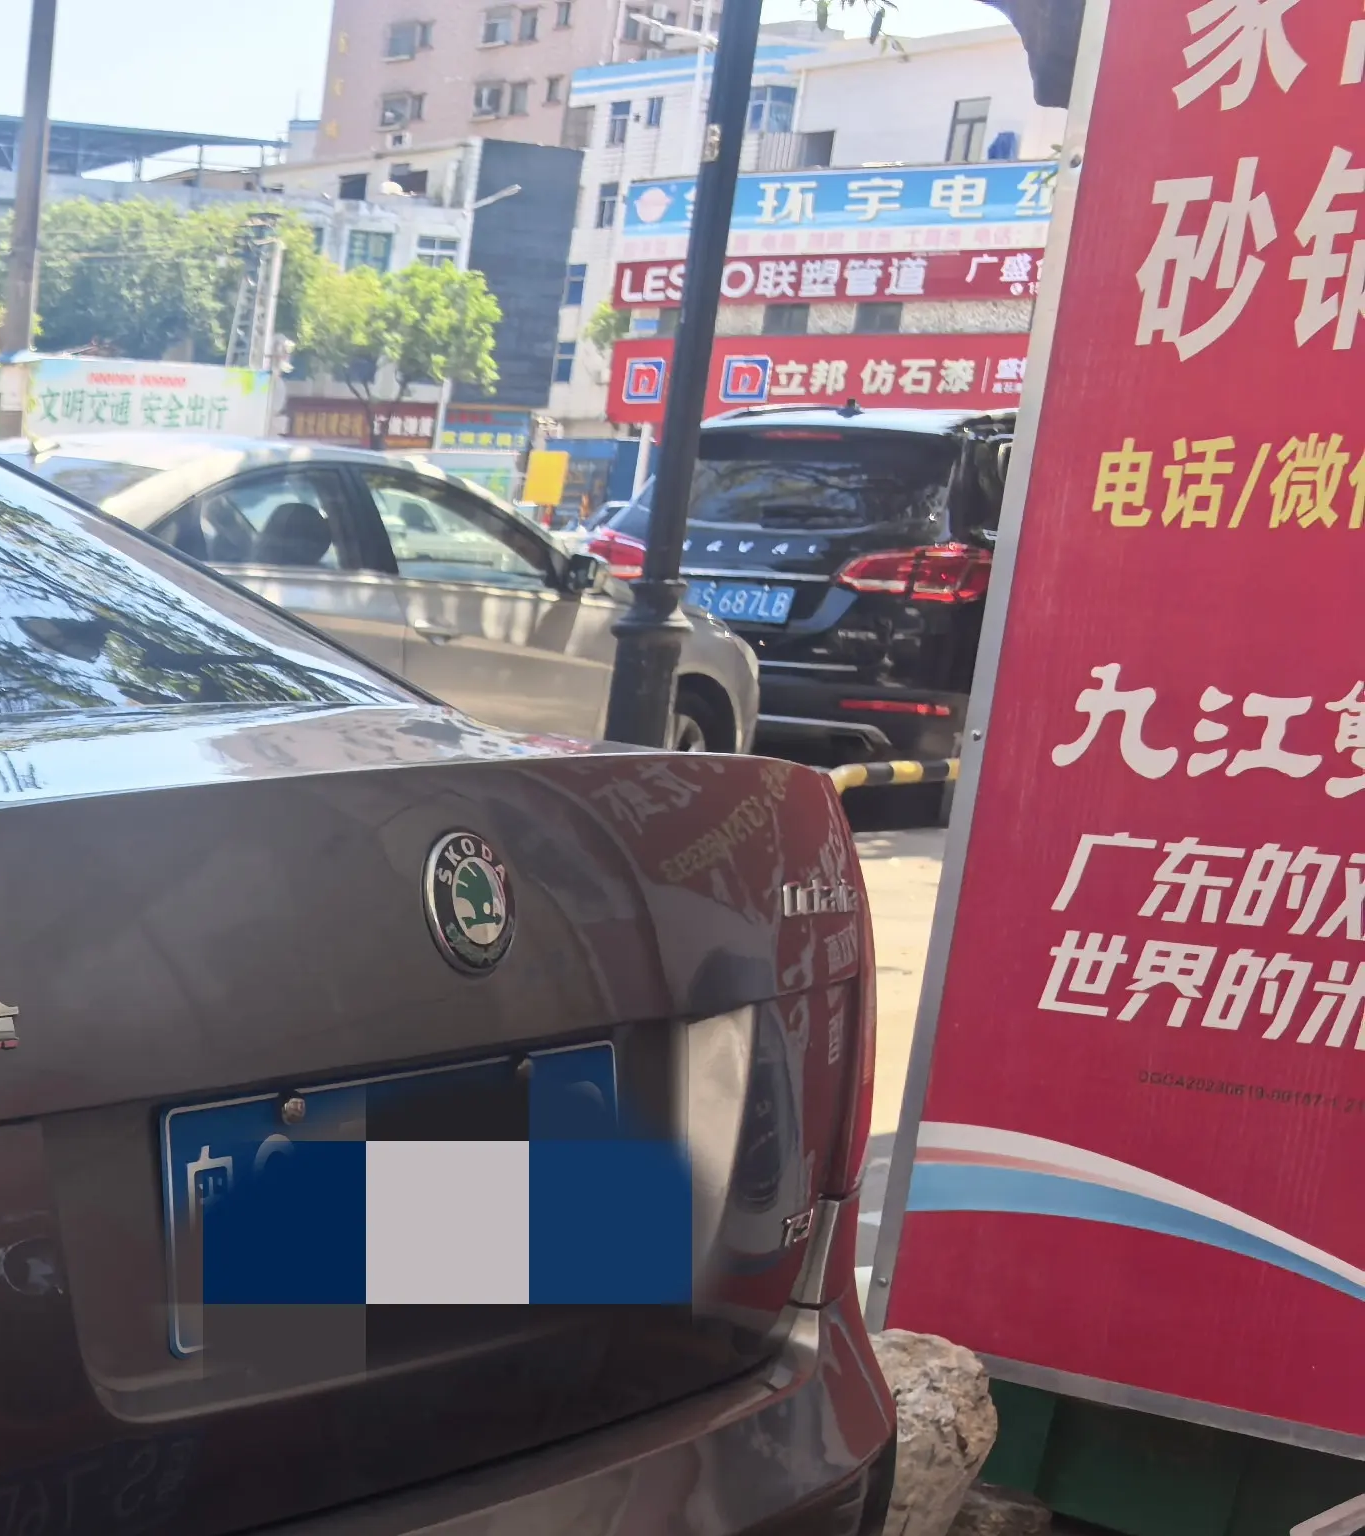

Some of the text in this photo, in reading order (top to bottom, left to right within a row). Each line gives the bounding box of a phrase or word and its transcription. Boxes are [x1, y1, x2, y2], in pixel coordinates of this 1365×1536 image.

[1172, 0, 1365, 111] 家
[38, 386, 230, 430] 文明交通 安全出行
[773, 358, 847, 396] 立邦
[1092, 432, 1365, 530] 电话/微
